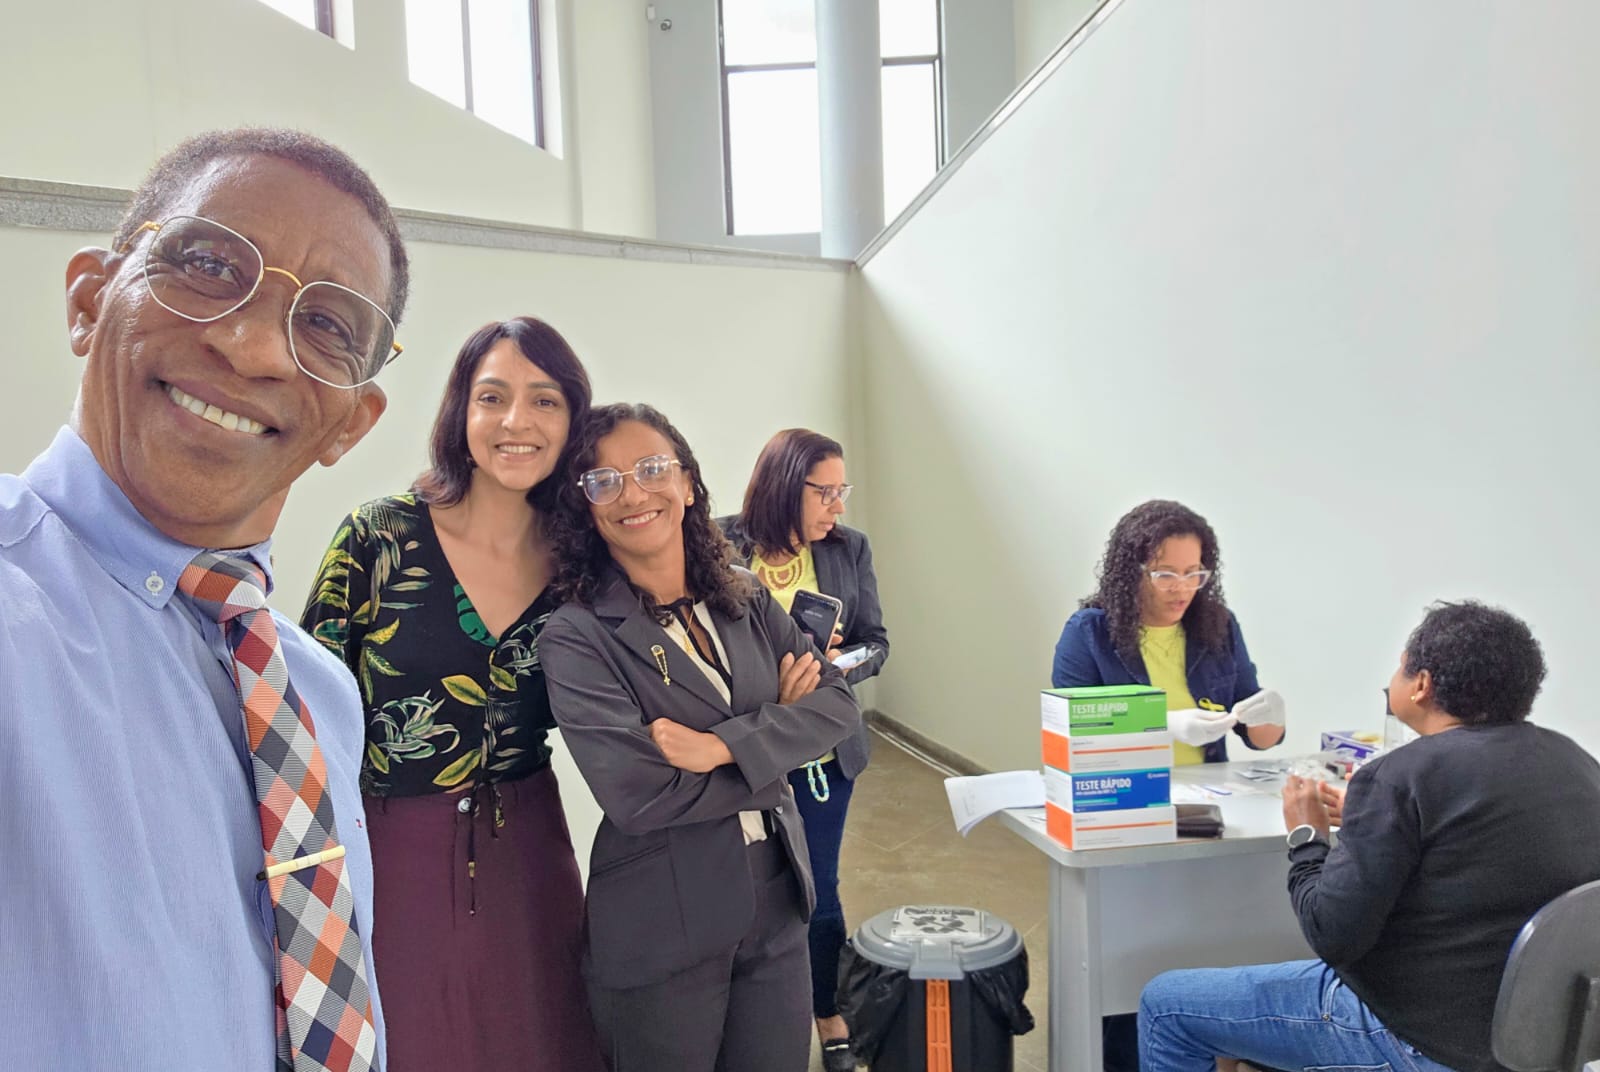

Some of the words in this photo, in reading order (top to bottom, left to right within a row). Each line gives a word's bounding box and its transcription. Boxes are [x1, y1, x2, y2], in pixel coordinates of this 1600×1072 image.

[1072, 704, 1096, 714] TESTE
[1075, 780, 1099, 790] TESTE
[1101, 777, 1132, 789] RÁPIDO
